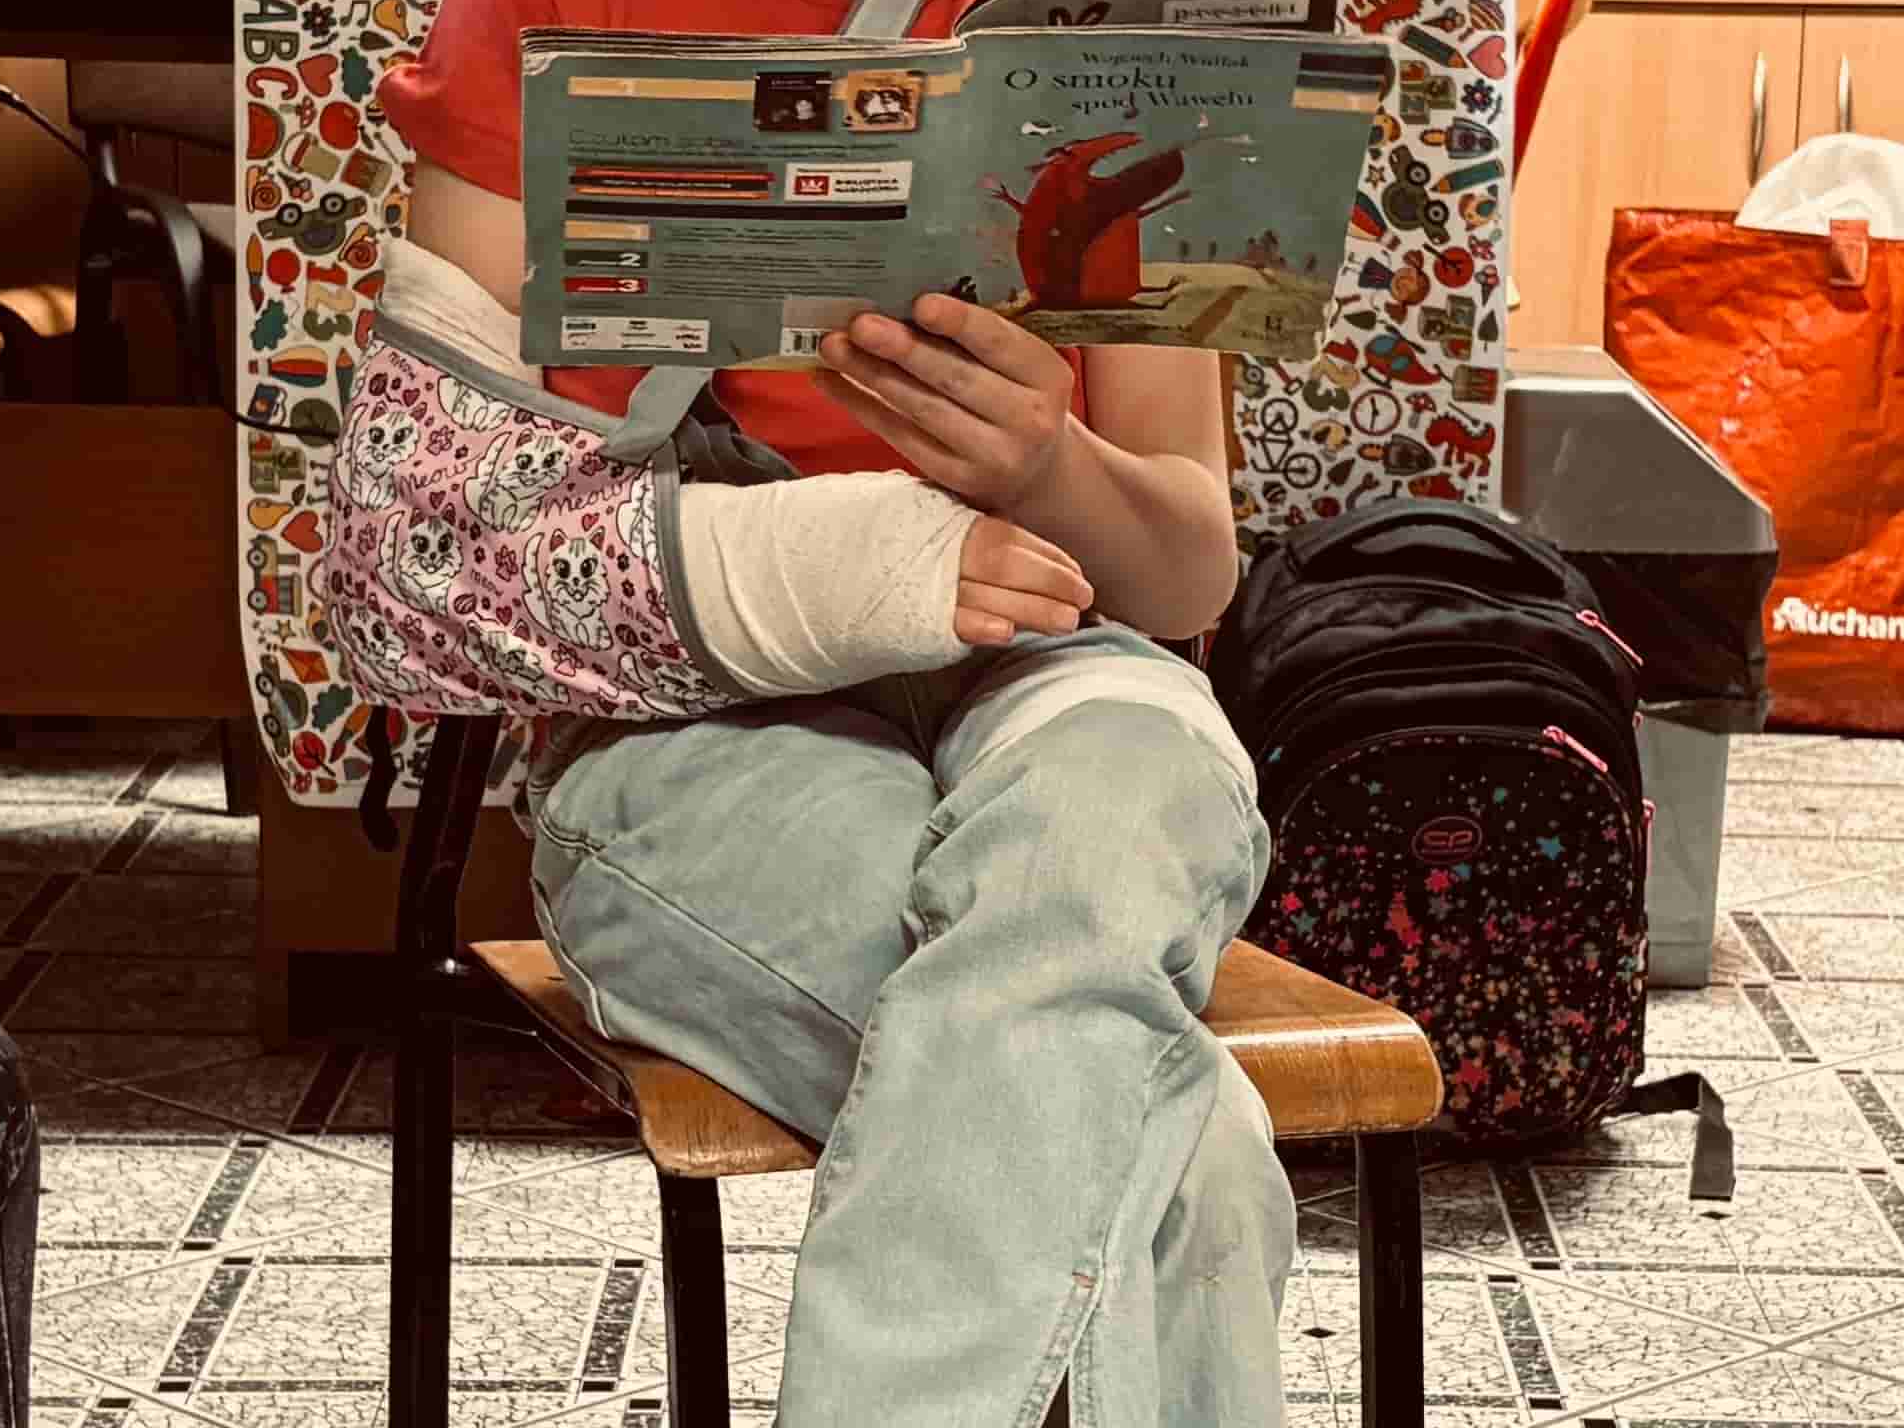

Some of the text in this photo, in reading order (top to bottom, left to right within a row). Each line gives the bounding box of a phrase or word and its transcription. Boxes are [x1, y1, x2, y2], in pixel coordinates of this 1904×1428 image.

[1004, 67, 1177, 90] O smoku
[1071, 93, 1138, 115] spod
[619, 254, 642, 268] 2
[618, 279, 639, 293] 3
